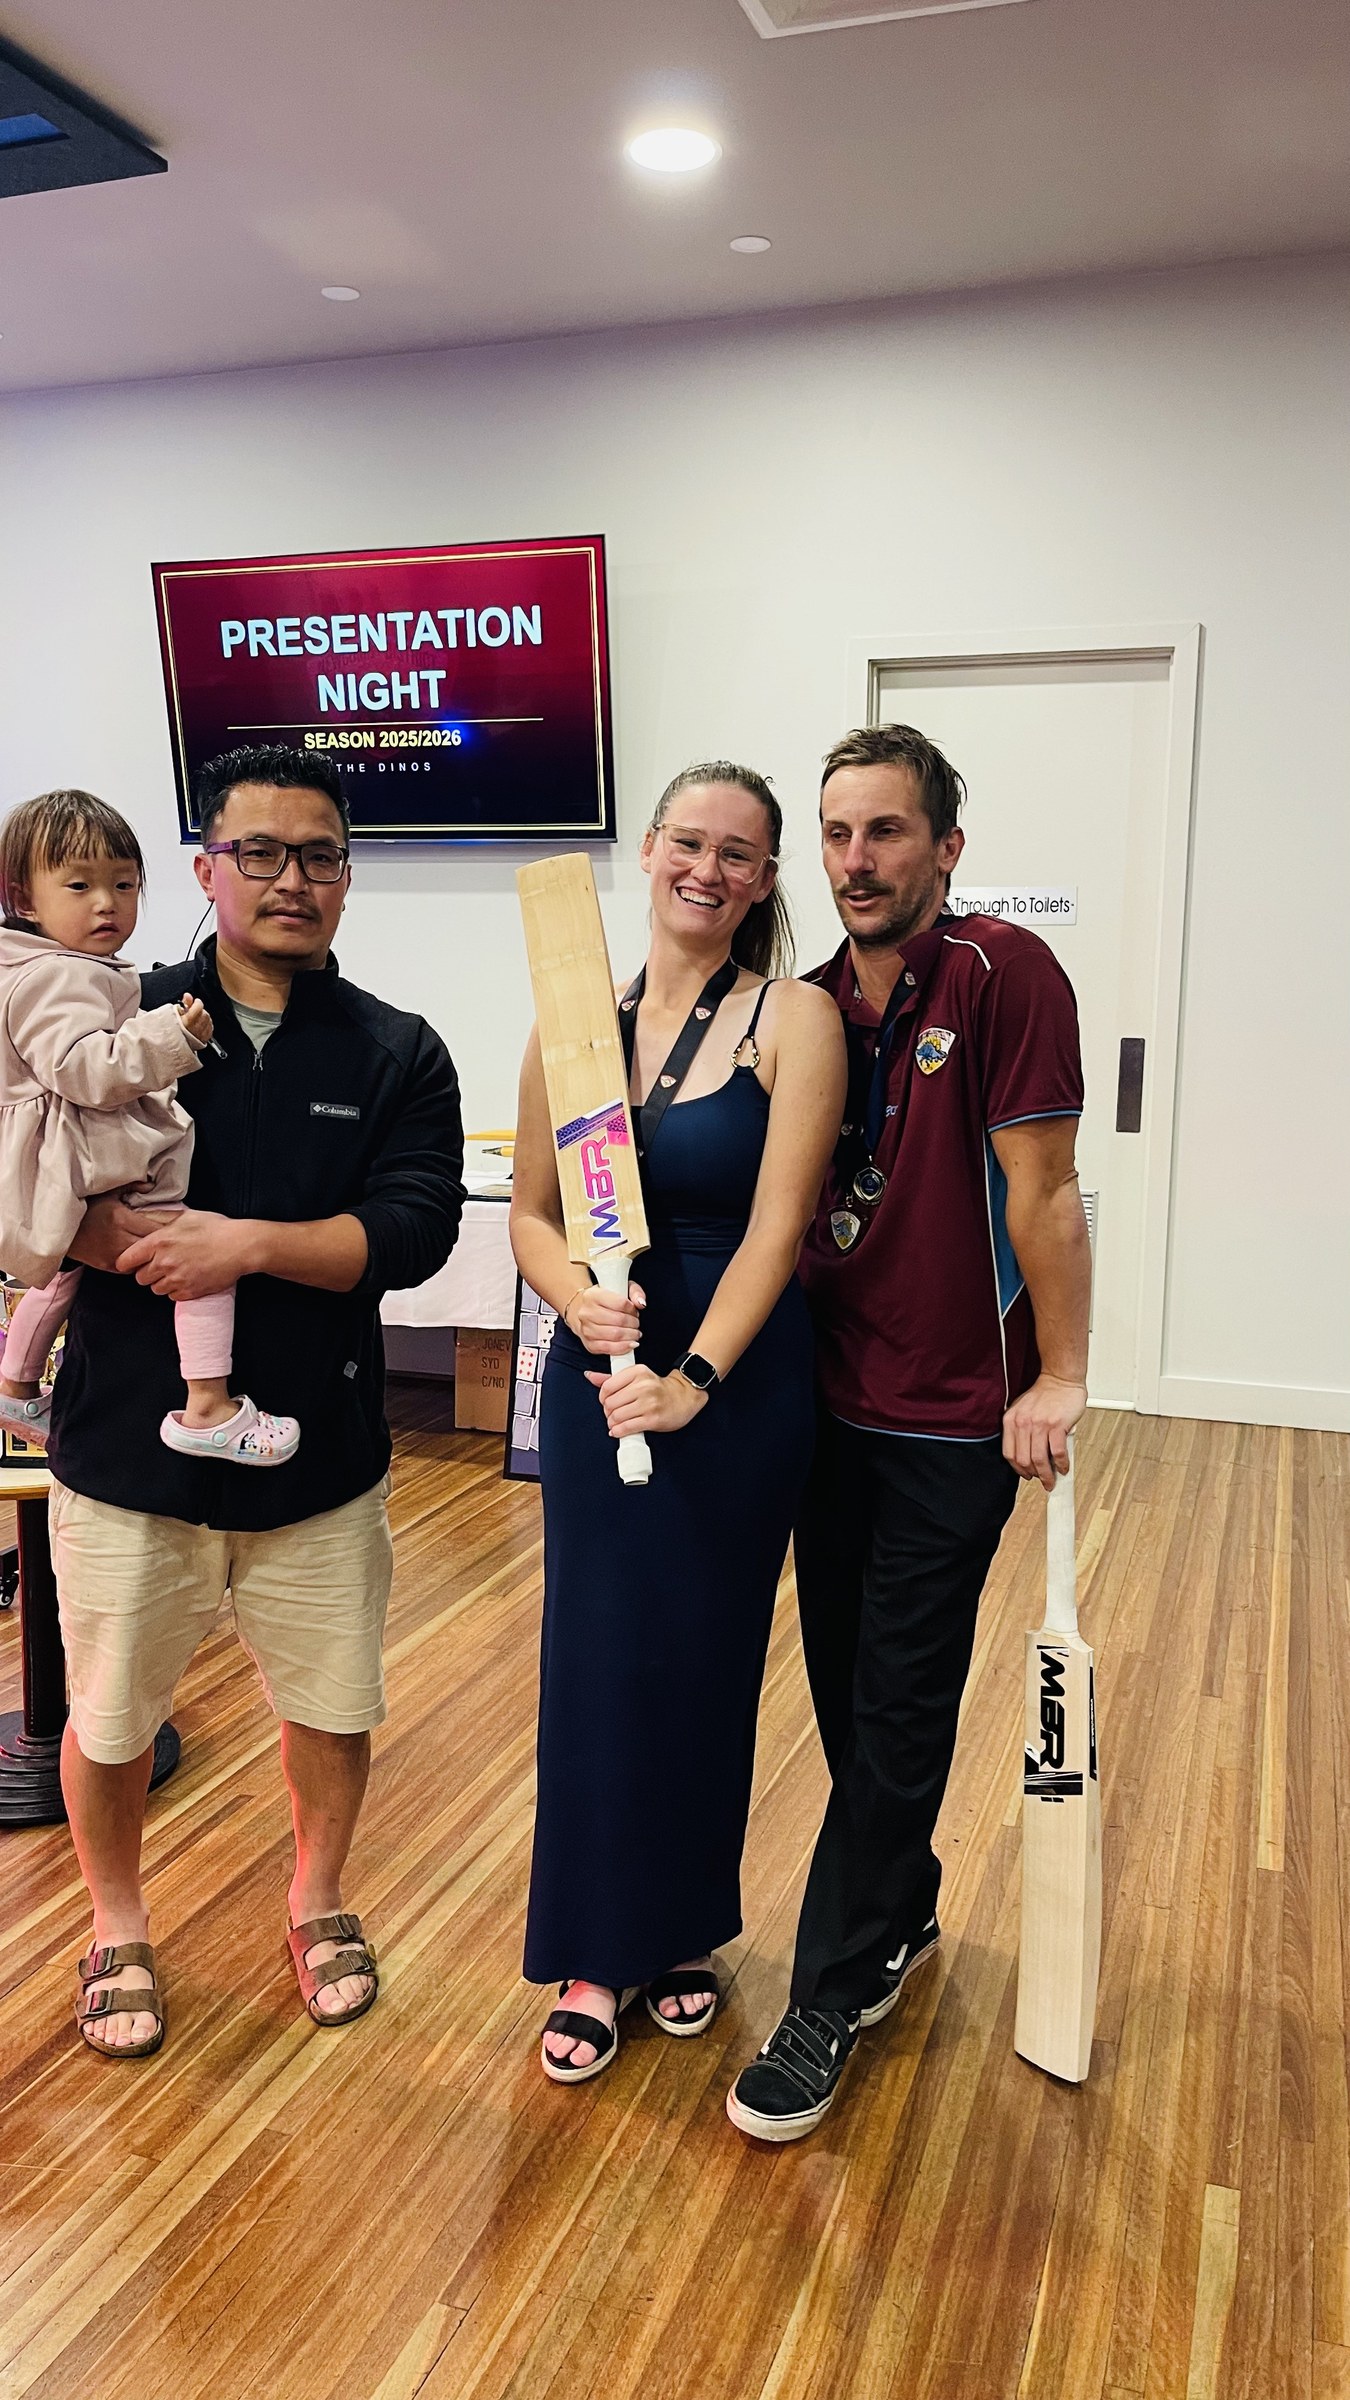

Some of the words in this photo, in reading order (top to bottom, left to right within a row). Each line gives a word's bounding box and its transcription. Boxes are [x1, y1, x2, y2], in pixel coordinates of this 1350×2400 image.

[220, 605, 542, 658] PRESENTATION
[316, 670, 446, 712] NIGHT
[304, 731, 375, 749] SEASON
[379, 729, 462, 748] 2025/2026
[336, 763, 366, 773] THE
[378, 762, 431, 772] DINOS
[1012, 897, 1027, 913] To
[321, 1105, 357, 1116] Columbia
[580, 1135, 622, 1238] MBR
[481, 1356, 500, 1370] SYD
[1040, 1650, 1066, 1770] MBR
